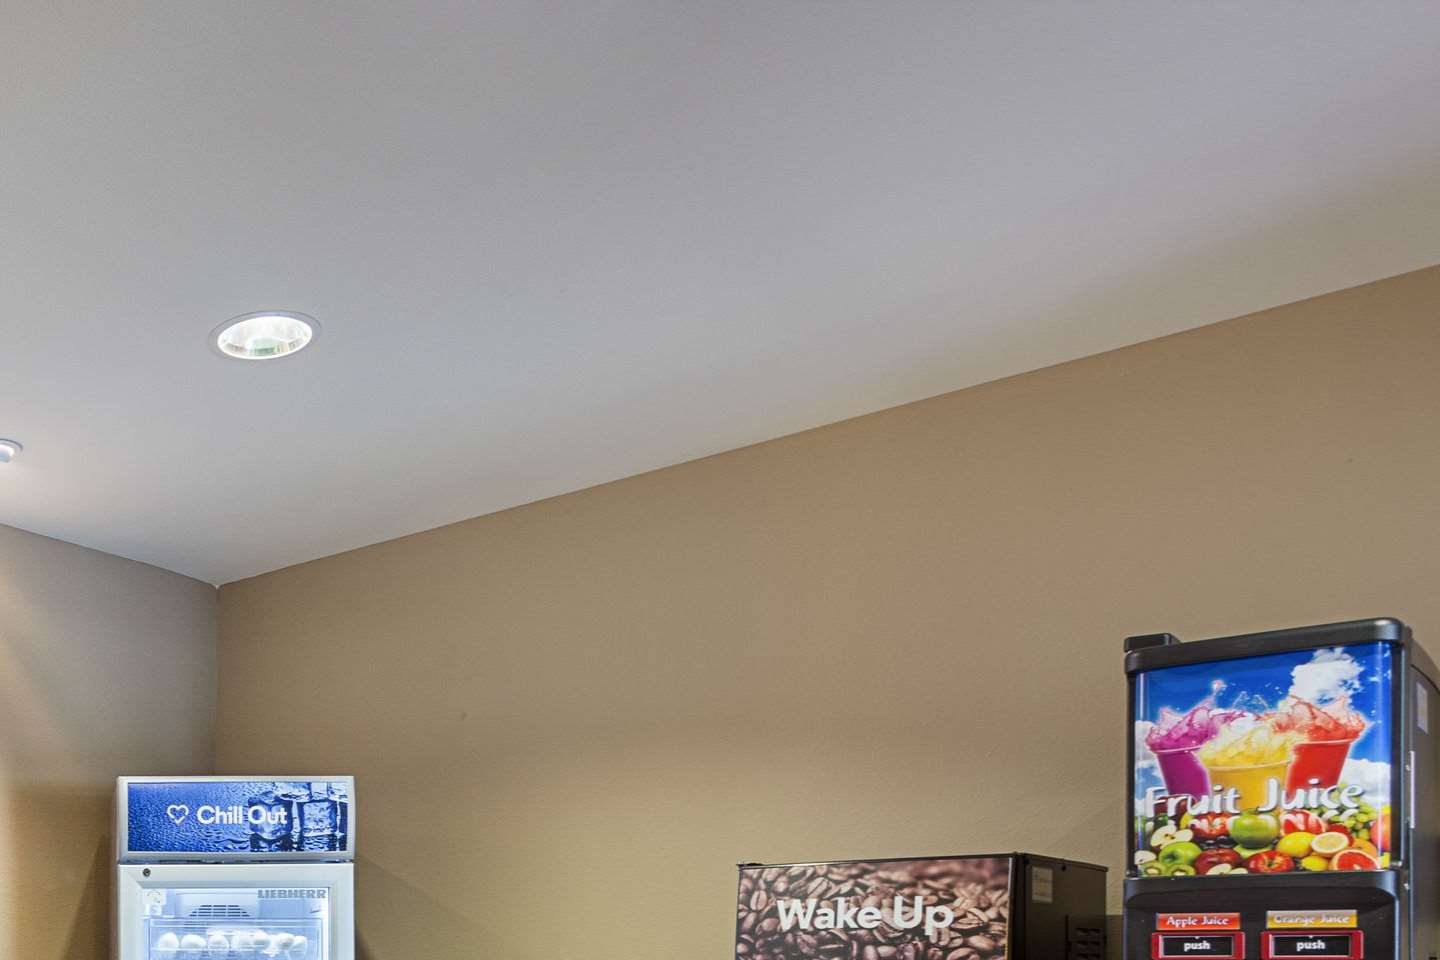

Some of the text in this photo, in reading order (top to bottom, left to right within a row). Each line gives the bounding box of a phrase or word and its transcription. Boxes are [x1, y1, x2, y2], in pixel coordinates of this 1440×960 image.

[1145, 777, 1365, 819] Fruit Juice
[196, 804, 288, 825] Chill Out
[257, 889, 327, 899] LIEBHERR
[776, 895, 955, 936] Wake Up
[1166, 914, 1229, 928] Apple Juice
[1319, 913, 1350, 924] Juice
[1183, 939, 1326, 951] push push
